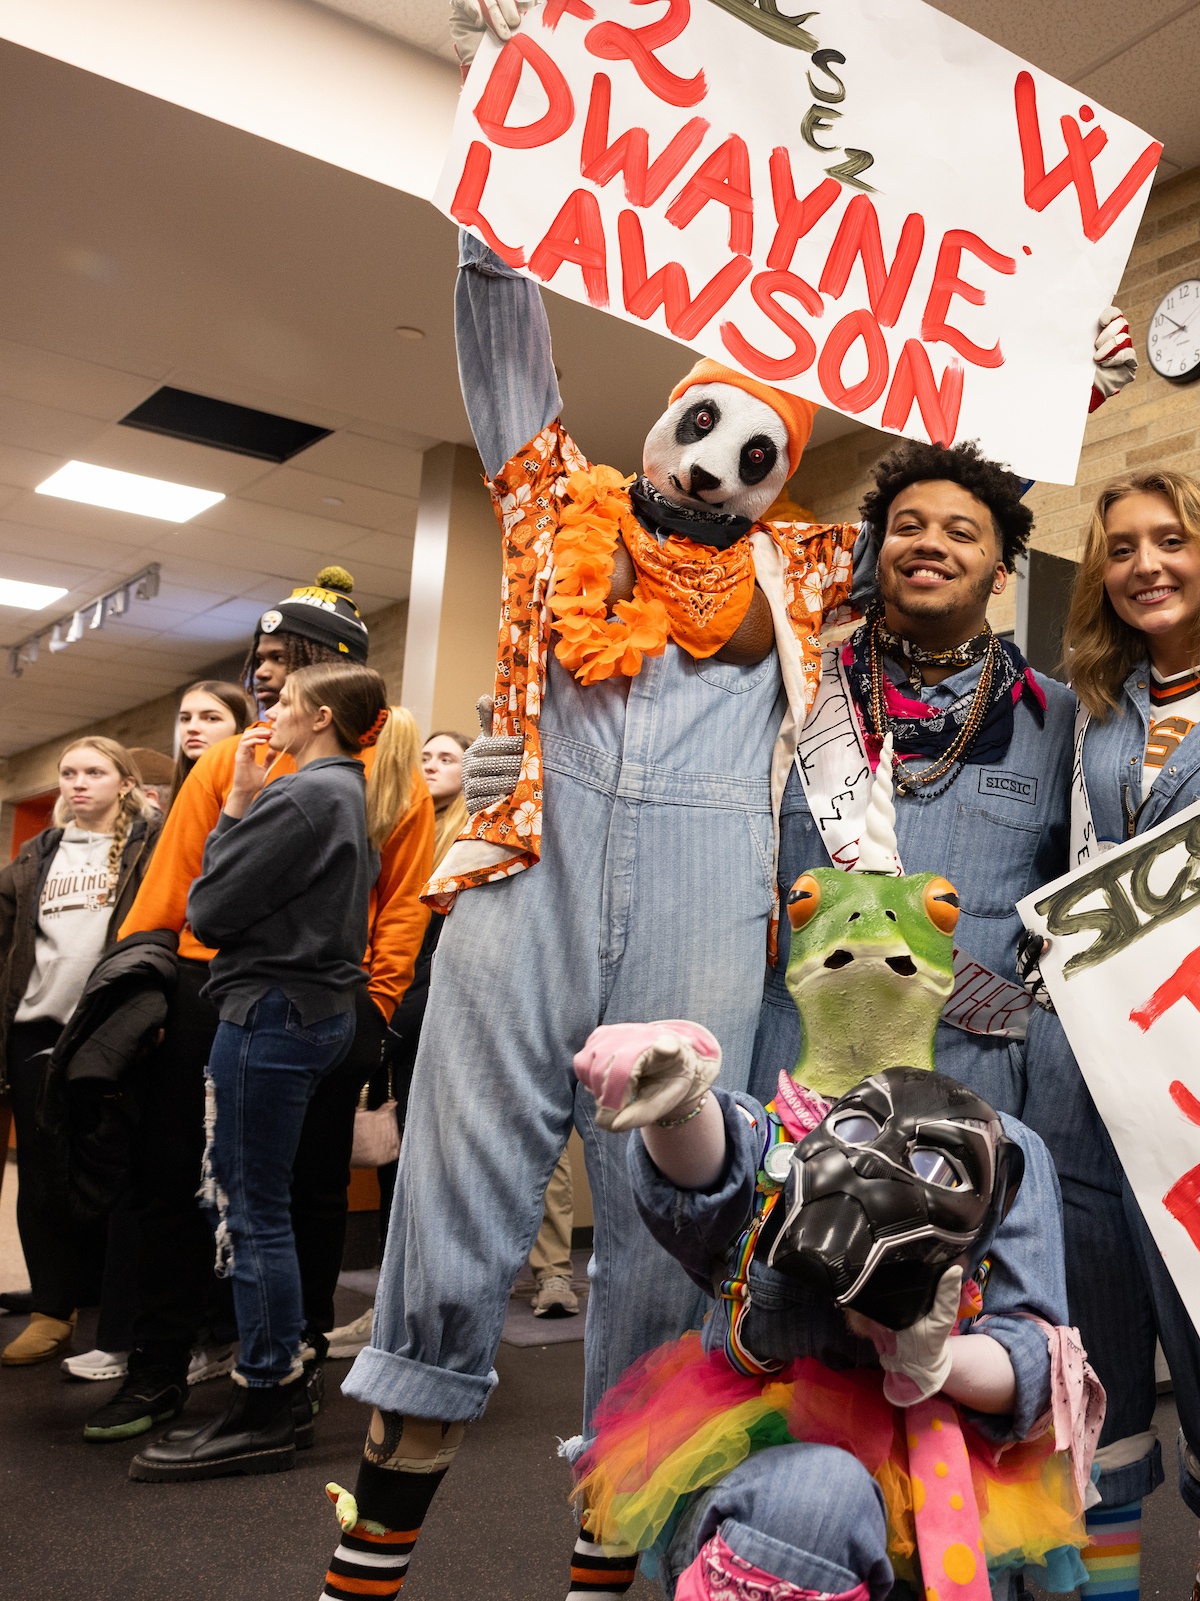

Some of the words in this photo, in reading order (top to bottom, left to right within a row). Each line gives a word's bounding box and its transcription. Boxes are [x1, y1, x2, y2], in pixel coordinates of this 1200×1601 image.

[449, 140, 965, 450] LAWSON
[473, 32, 1017, 368] DWAYNE
[986, 776, 1031, 796] SICSIC
